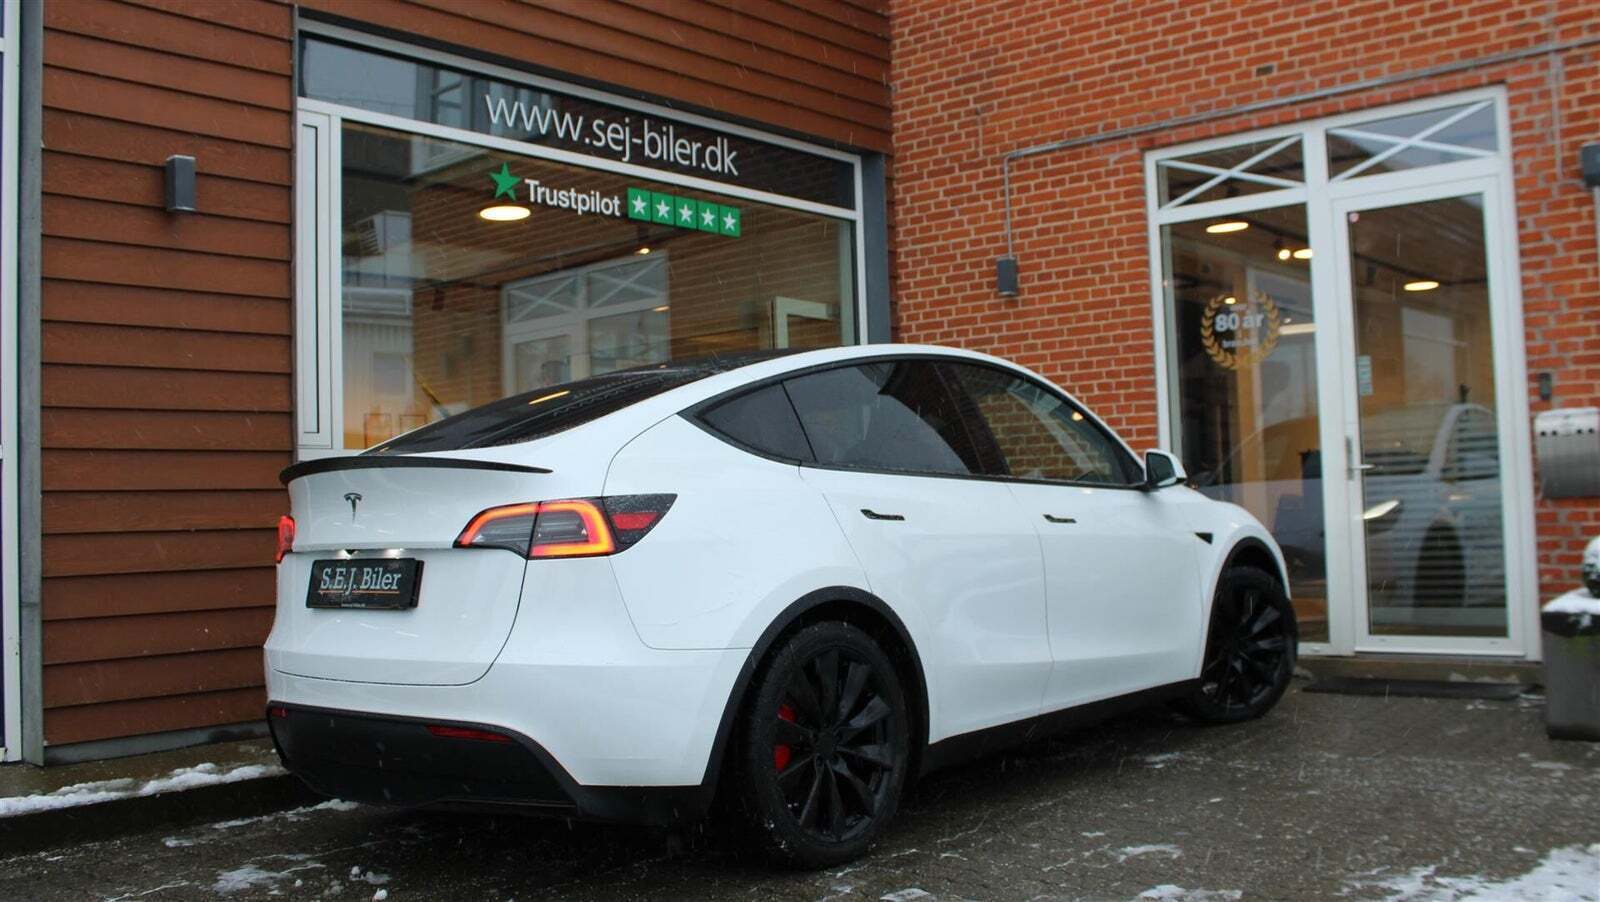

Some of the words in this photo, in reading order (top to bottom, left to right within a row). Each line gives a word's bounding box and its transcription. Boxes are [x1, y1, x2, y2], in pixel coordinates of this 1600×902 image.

[486, 93, 739, 176] www.sej-biler.dk
[524, 178, 621, 217] Trustpilot
[1215, 314, 1240, 332] 80
[319, 567, 358, 596] S.E.J.
[360, 566, 402, 590] Biler
